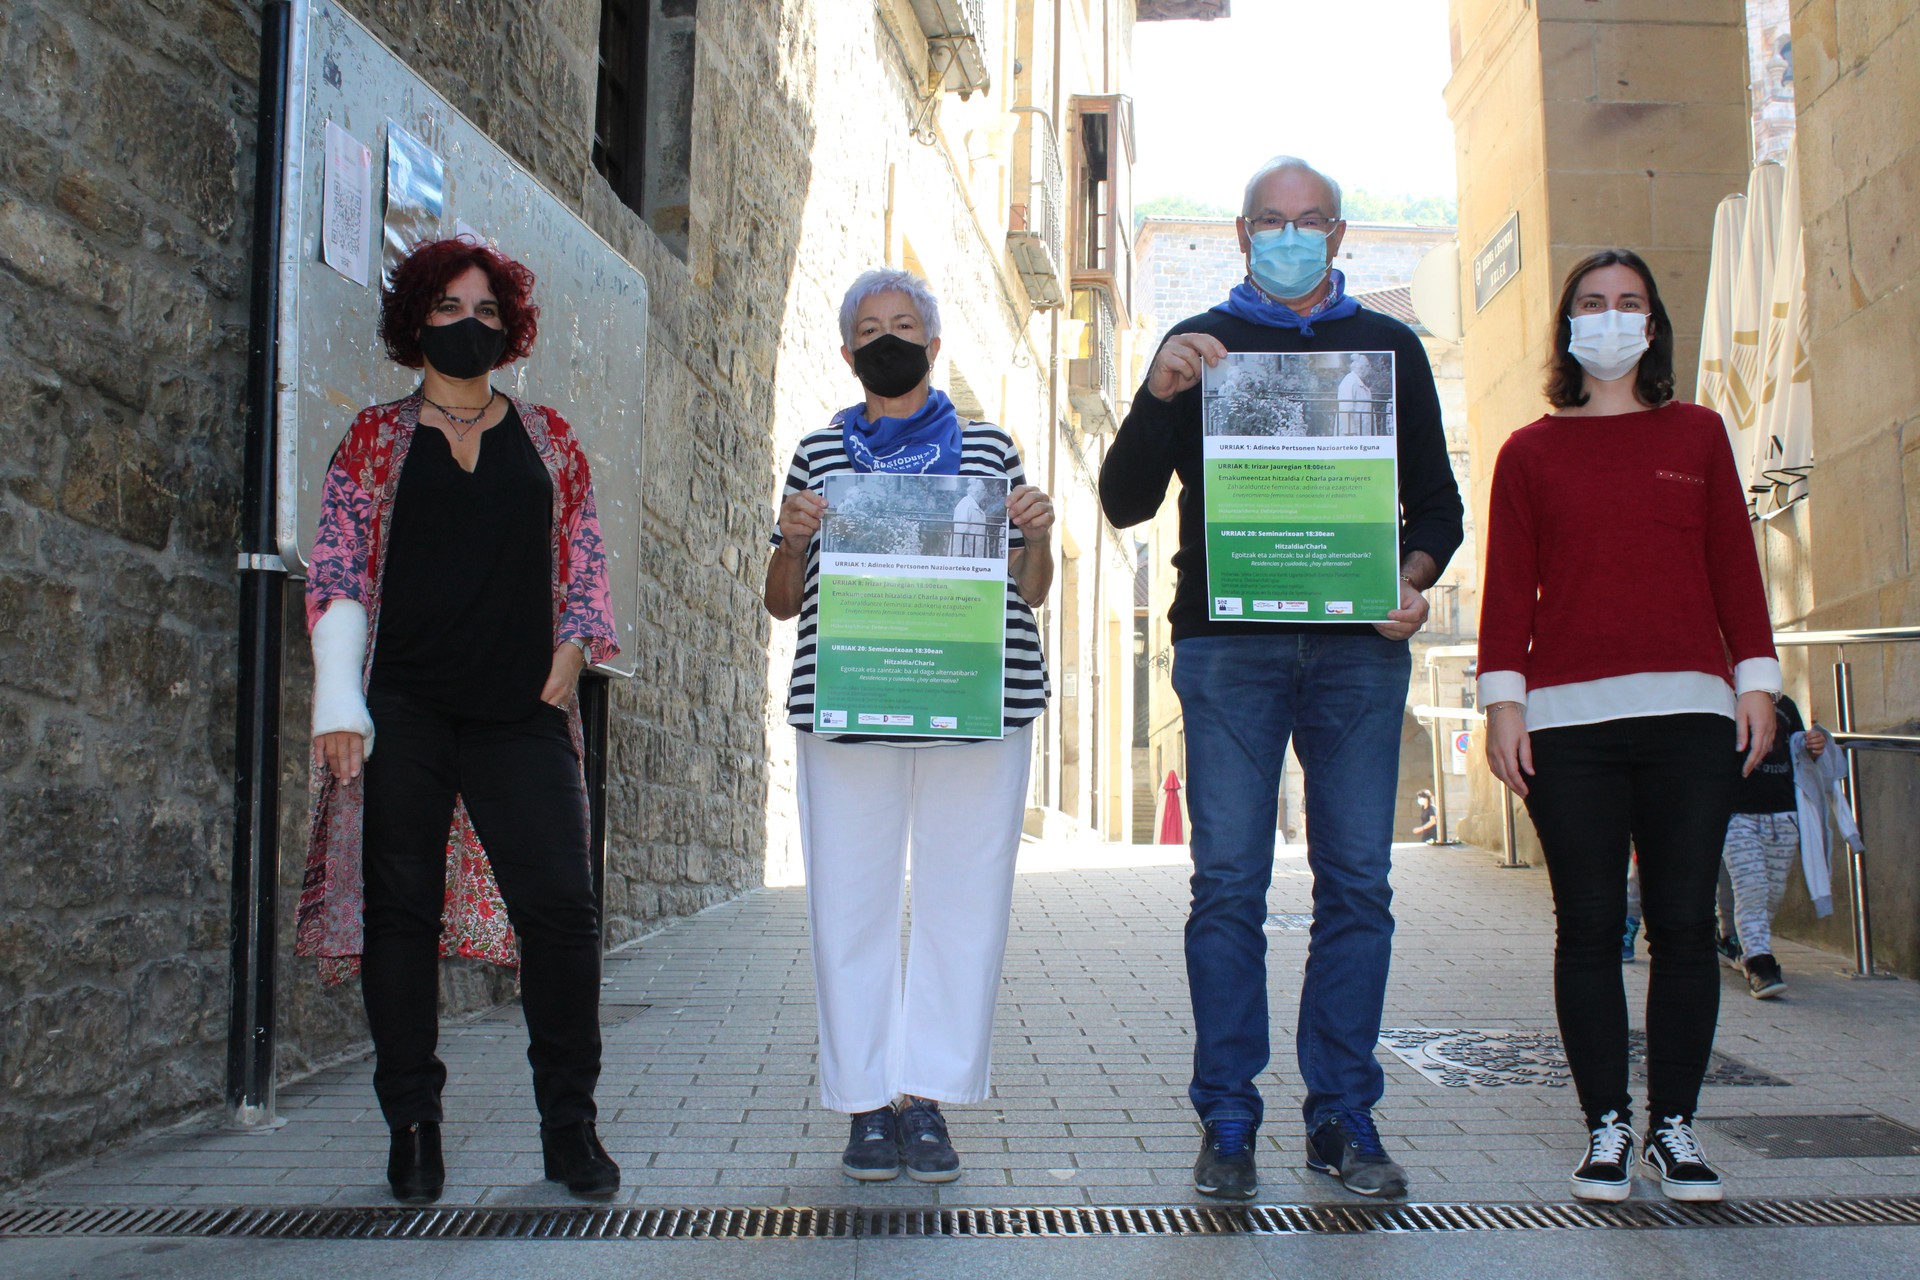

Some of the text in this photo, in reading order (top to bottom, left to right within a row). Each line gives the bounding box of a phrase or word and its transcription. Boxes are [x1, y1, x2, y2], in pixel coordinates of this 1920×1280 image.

[1232, 552, 1256, 560] Egoitzak
[1309, 552, 1326, 560] dago
[896, 563, 929, 571] Pertsonen
[930, 564, 970, 572] Nazioarteko
[971, 566, 992, 574] Eguna
[868, 646, 914, 654] Seminarixoan
[915, 647, 943, 655] 18:30ean
[884, 658, 935, 667] Hitzaldia/Charla
[841, 666, 865, 674] Egoitzak
[878, 667, 903, 675] zaintzak:
[920, 669, 936, 677] dago
[938, 669, 978, 677] alternatibarik?
